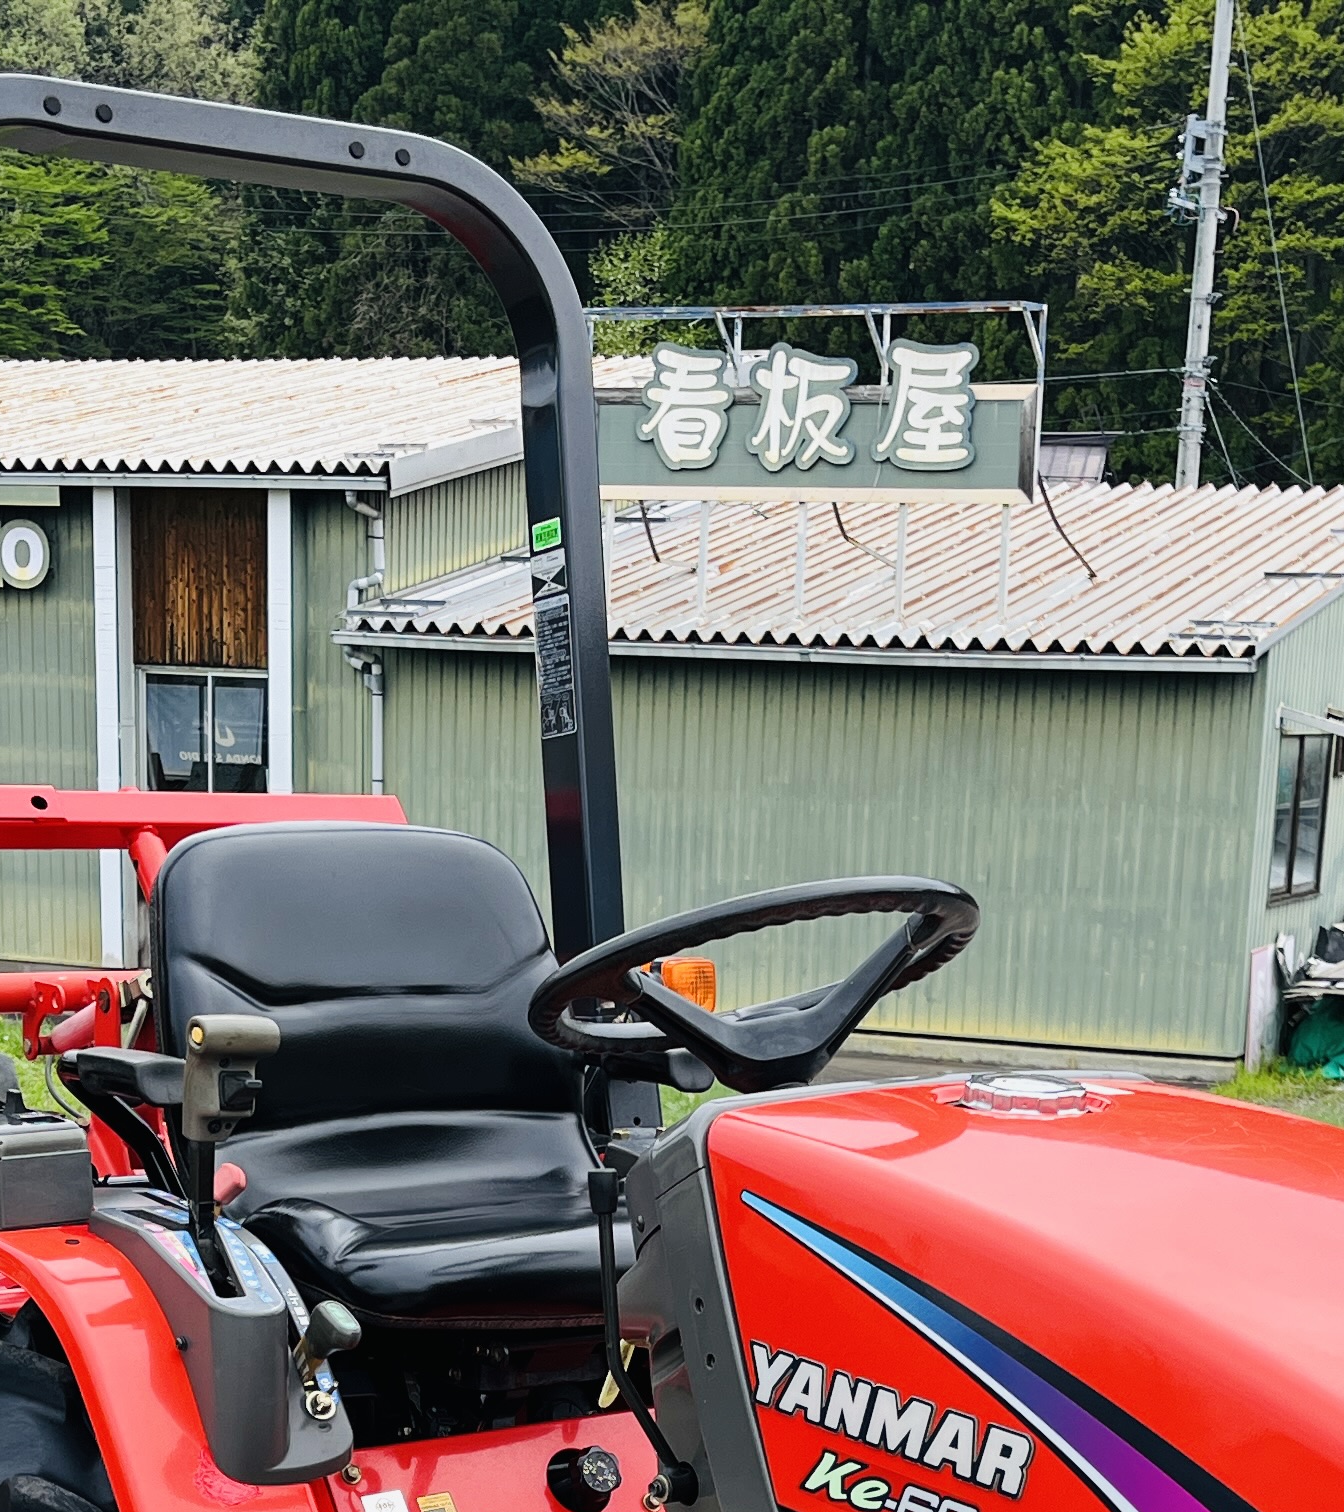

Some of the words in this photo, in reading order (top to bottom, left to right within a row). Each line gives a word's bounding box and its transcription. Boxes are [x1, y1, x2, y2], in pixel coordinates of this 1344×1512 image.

[640, 346, 974, 465] 看板屋
[751, 1340, 1036, 1500] YANMAR
